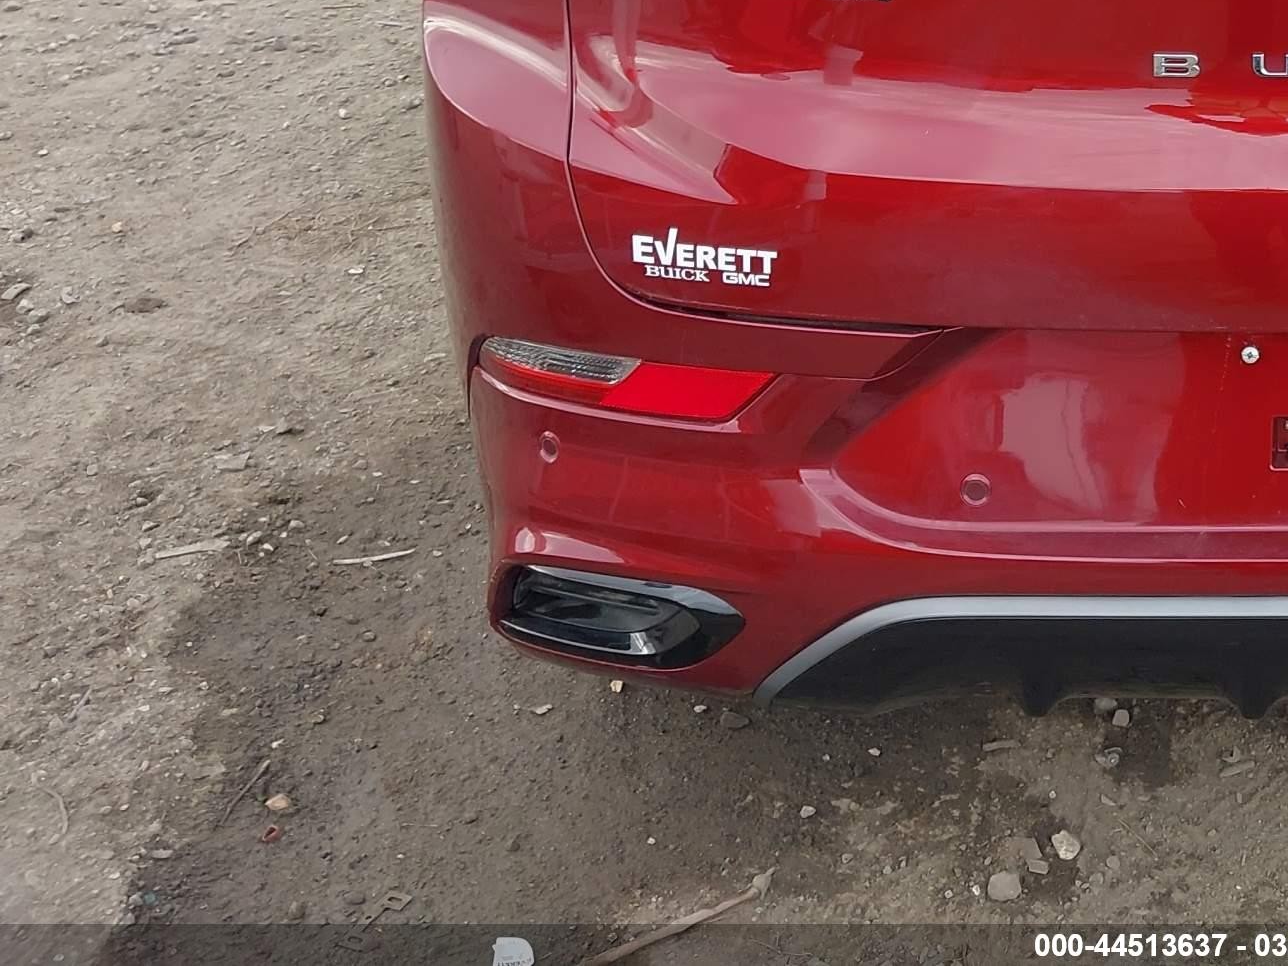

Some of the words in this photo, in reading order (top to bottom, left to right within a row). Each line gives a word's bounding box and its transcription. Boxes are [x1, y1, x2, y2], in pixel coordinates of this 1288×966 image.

[631, 227, 778, 275] EVERETT
[644, 264, 710, 282] BUICK
[722, 272, 770, 287] GMC
